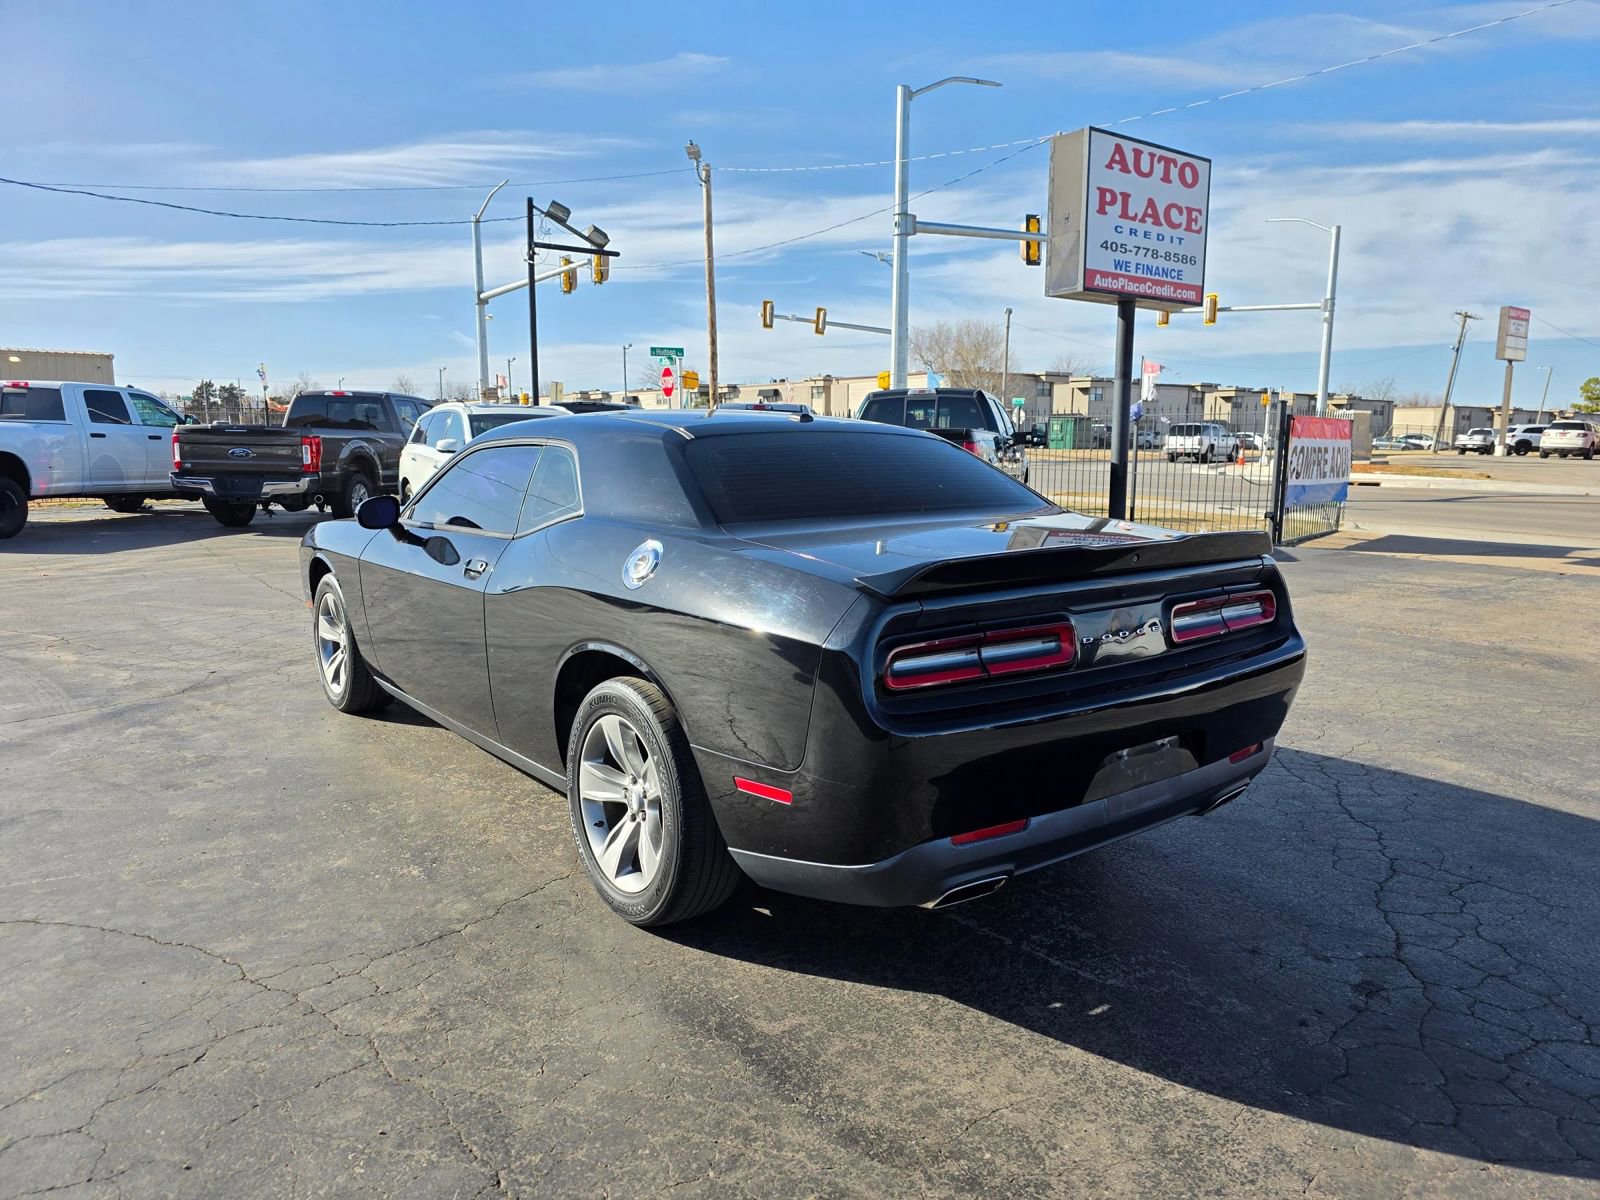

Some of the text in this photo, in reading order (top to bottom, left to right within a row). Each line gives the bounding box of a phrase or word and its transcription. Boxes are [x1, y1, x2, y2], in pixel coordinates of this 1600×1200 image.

[1104, 142, 1199, 189] AUTO
[1096, 186, 1203, 235] PLACE
[1114, 225, 1185, 245] CREDIT
[1099, 239, 1197, 266] 405-778-8586
[1113, 258, 1184, 281] WE FINANCE
[1094, 273, 1196, 300] AutoPlaceCredit.com
[655, 348, 677, 357] Hudson
[662, 376, 673, 389] STOP
[1289, 445, 1329, 480] COMPRE
[1082, 624, 1160, 644] DODGE
[588, 694, 618, 709] KUMHO
